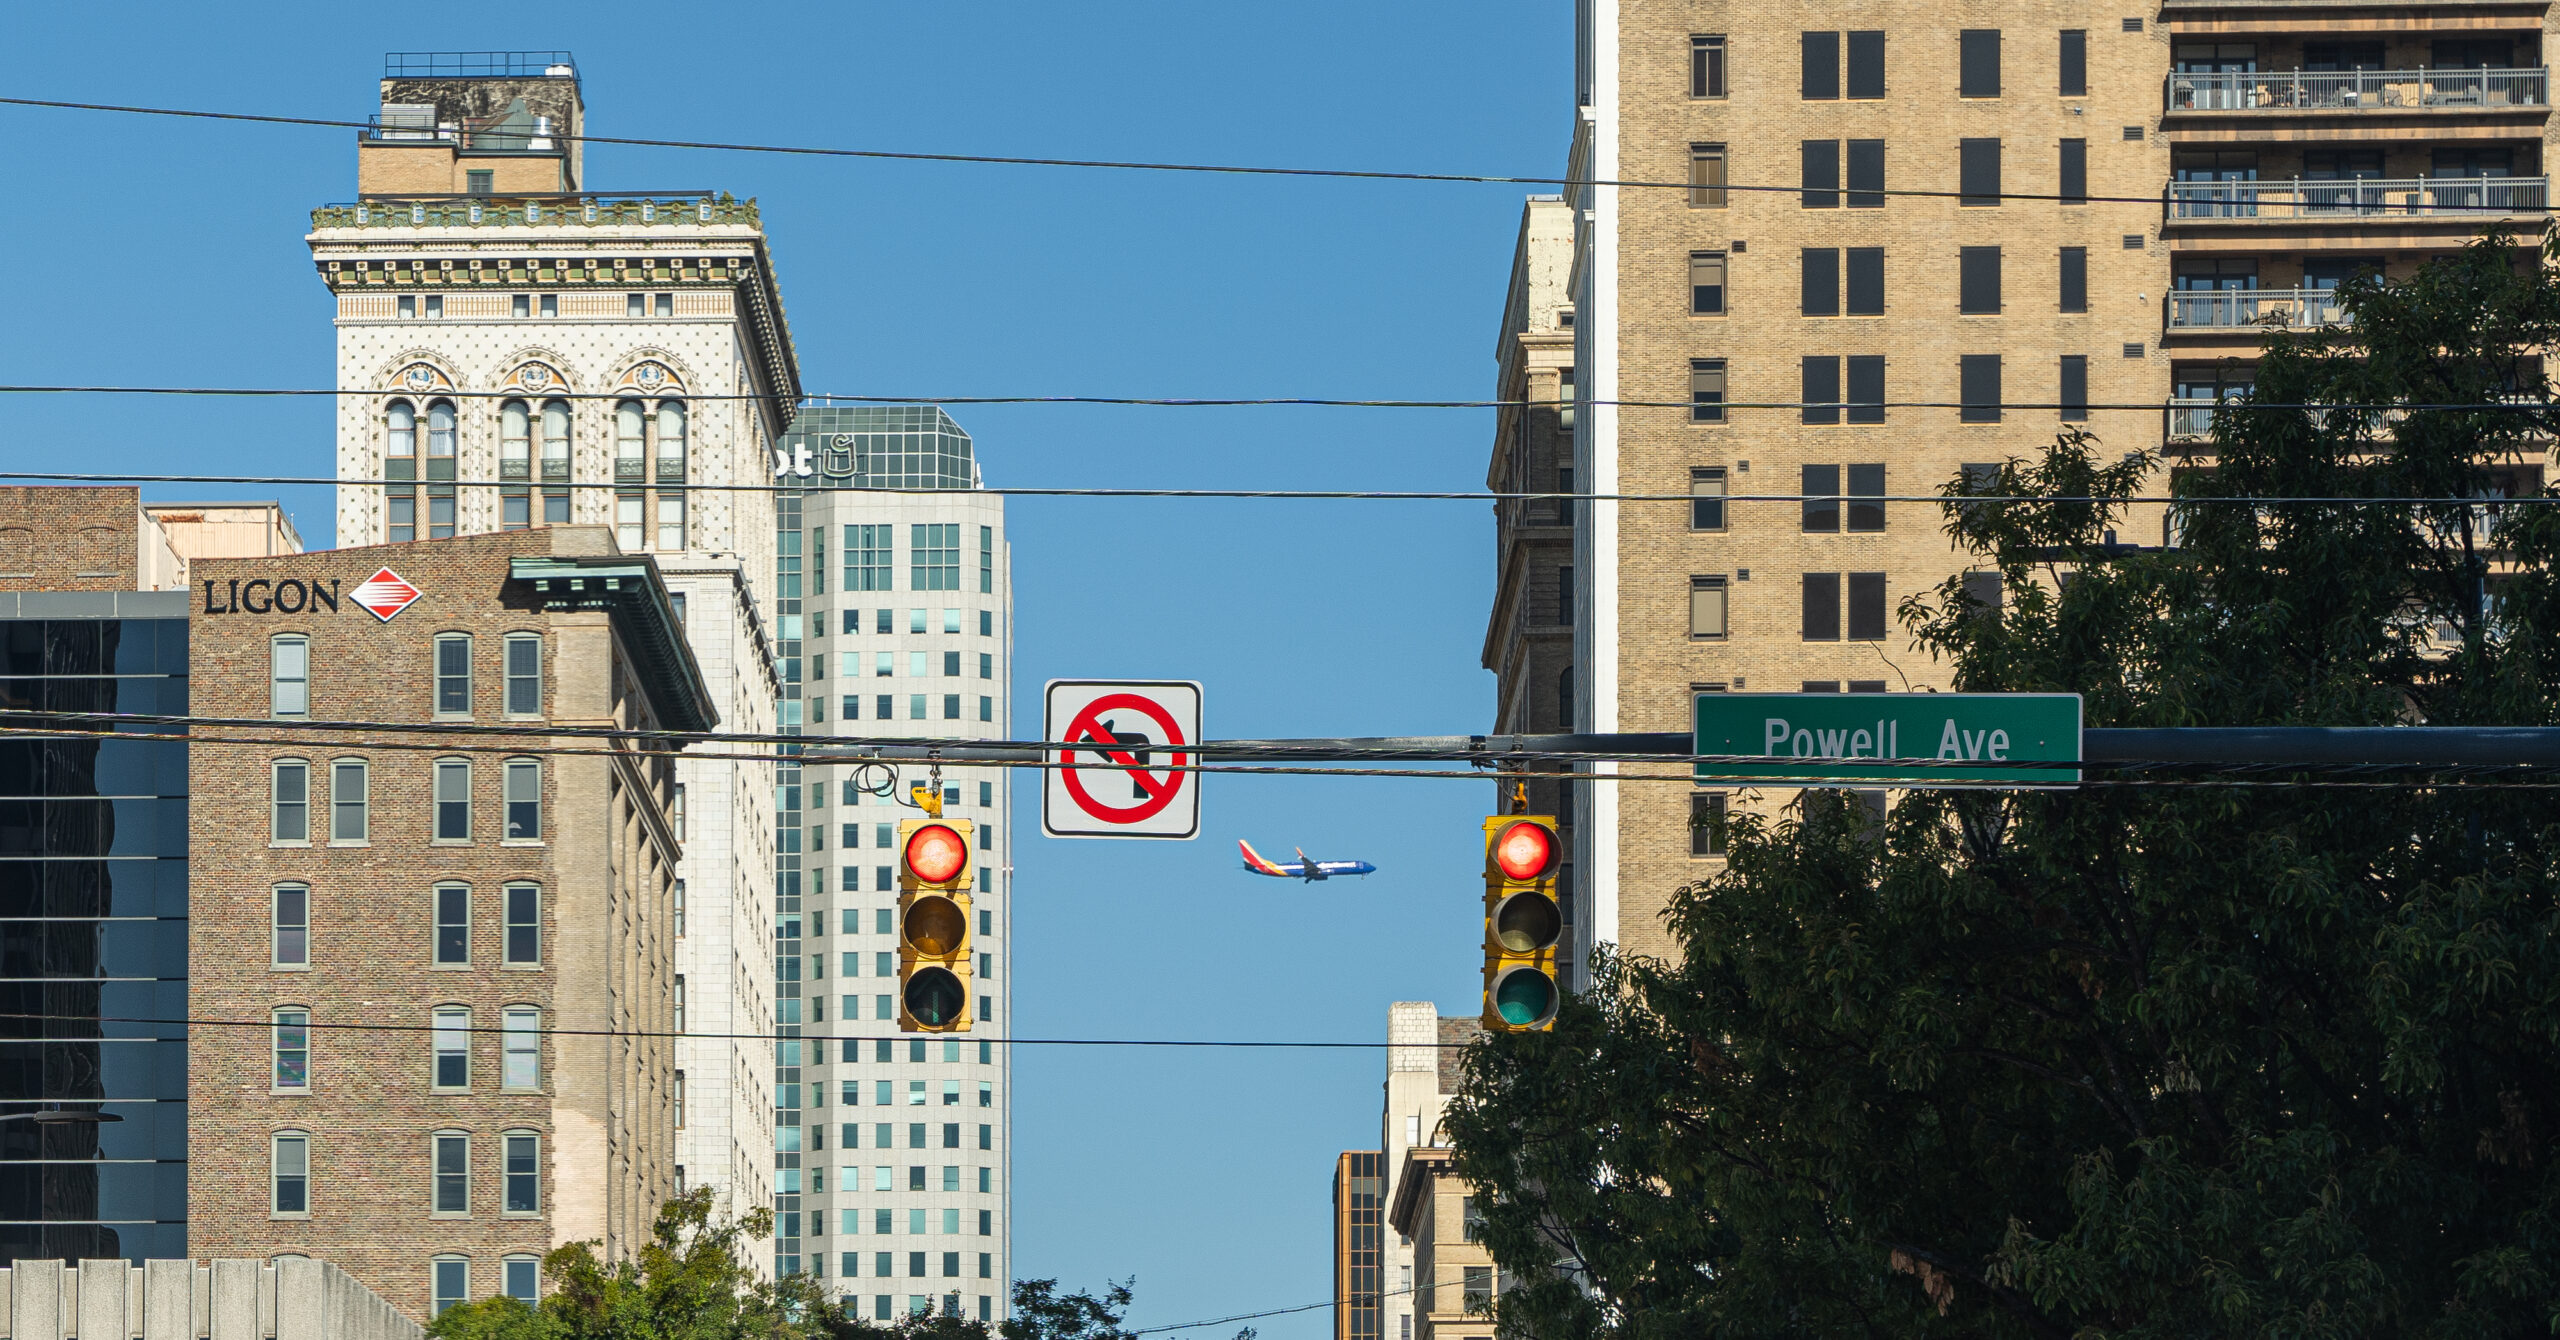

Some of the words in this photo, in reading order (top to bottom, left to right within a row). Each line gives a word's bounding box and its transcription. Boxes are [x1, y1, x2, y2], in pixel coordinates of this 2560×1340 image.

[357, 207, 368, 224] E
[413, 206, 424, 223] E
[470, 206, 481, 223] E
[527, 205, 539, 222] E
[586, 205, 597, 222] E
[643, 204, 654, 221] E
[700, 204, 711, 221] E
[203, 578, 341, 614] LIGON
[1764, 718, 1897, 759] Powell
[1936, 718, 2010, 761] Ave
